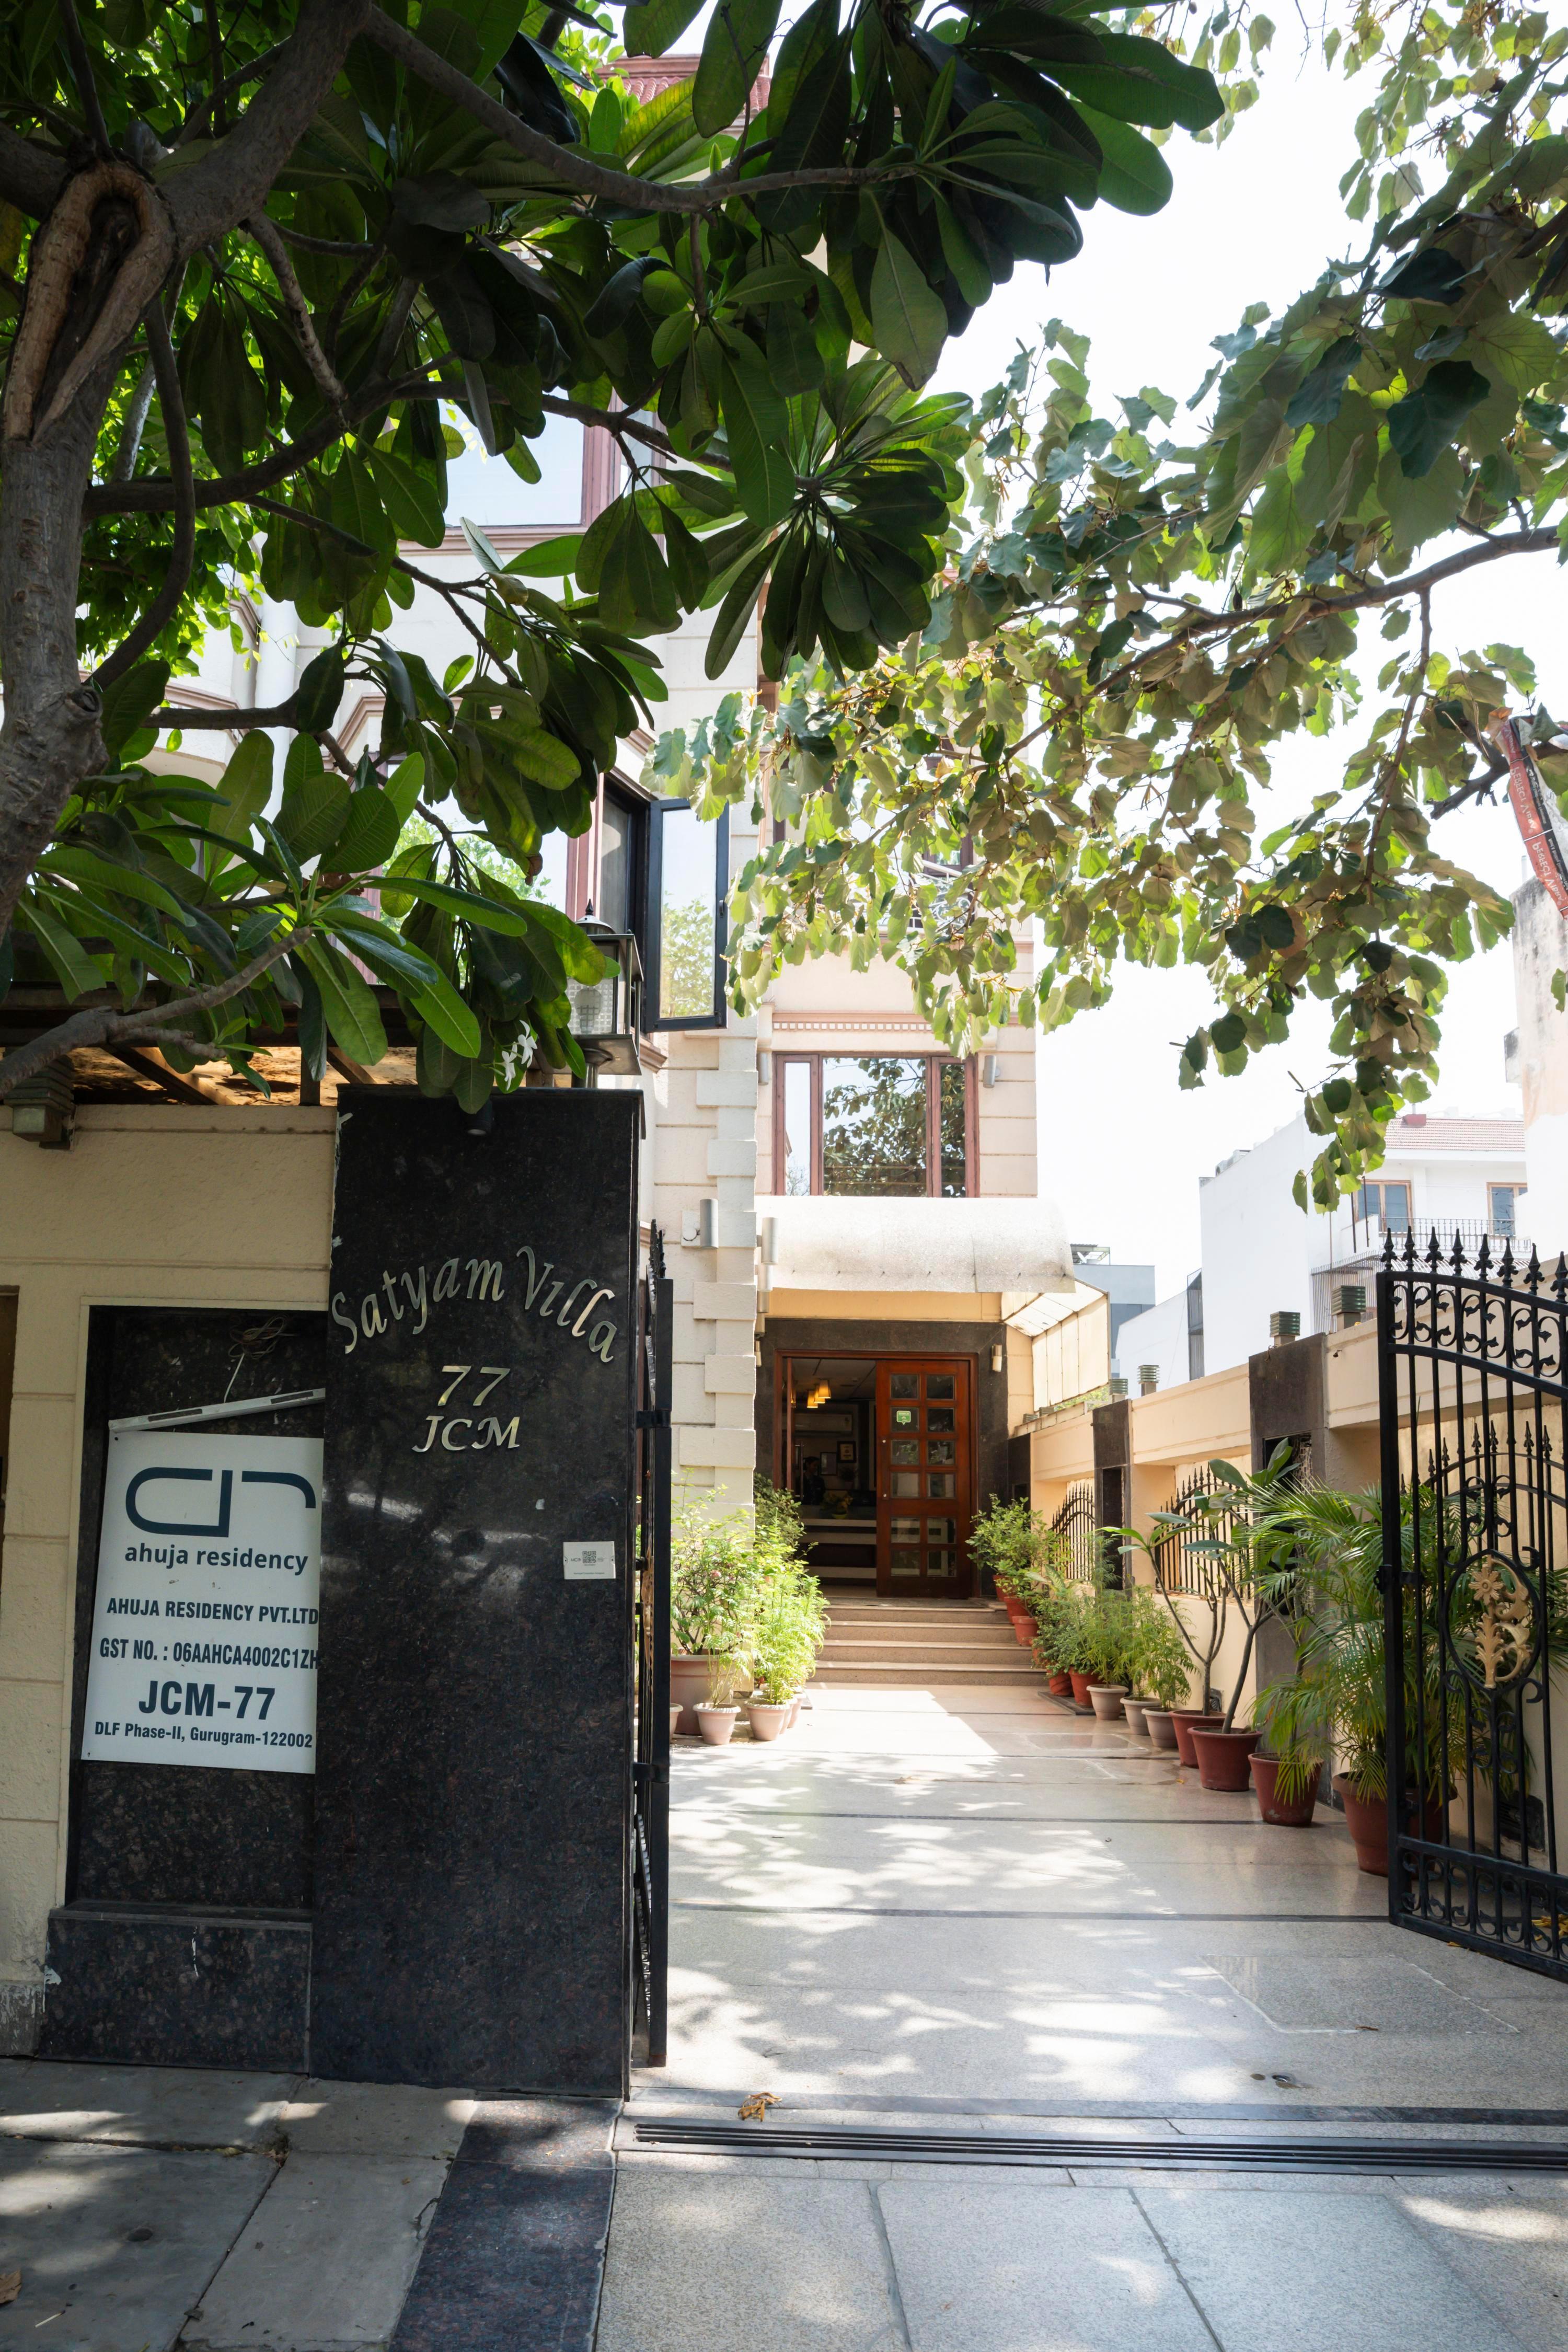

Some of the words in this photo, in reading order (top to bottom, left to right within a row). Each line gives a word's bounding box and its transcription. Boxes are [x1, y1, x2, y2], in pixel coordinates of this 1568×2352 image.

[331, 1258, 505, 1354] Satyam
[437, 1365, 511, 1406] 77
[411, 1415, 521, 1453] JCM
[124, 1542, 189, 1569] ahuja
[196, 1547, 308, 1576] residency
[107, 1598, 159, 1616] AHUJA
[165, 1601, 254, 1621] RESIDENCY
[258, 1606, 319, 1624] PVT.LTD
[100, 1638, 129, 1658] GST
[133, 1640, 157, 1660] NO.
[173, 1642, 318, 1669] 06AAHCA4002C1ZH
[139, 1680, 275, 1720] JCM-77
[95, 1721, 120, 1736] DLF
[124, 1723, 185, 1743] Phase-II,
[190, 1727, 313, 1748] Gurugram-122002
